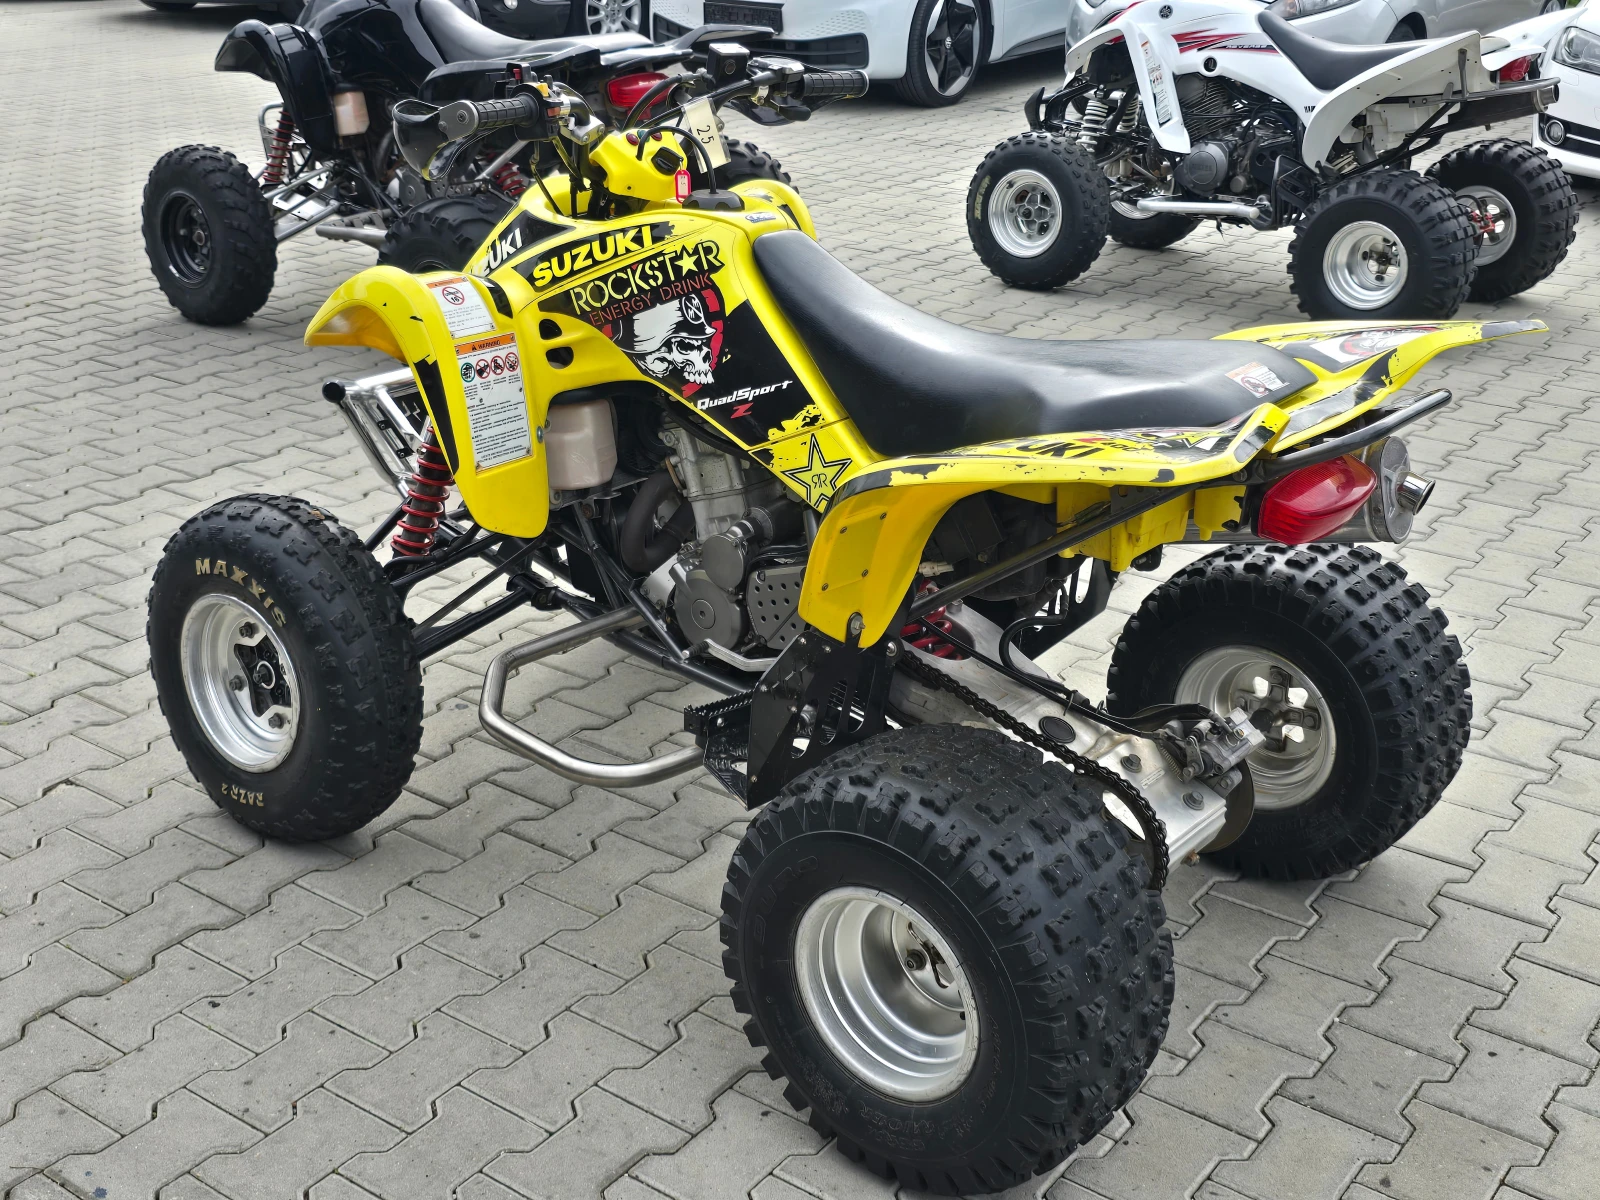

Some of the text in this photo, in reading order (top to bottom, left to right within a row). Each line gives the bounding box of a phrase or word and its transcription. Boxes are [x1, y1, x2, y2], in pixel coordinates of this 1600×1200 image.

[697, 125, 715, 144] 25
[532, 224, 655, 288] SUZUKI
[589, 272, 713, 326] ENERGY DRINK
[477, 339, 501, 350] WARNING
[697, 380, 793, 410] QuadSport
[730, 403, 754, 419] Z
[195, 557, 287, 628] MAXXIS
[231, 784, 264, 807] RAZR
